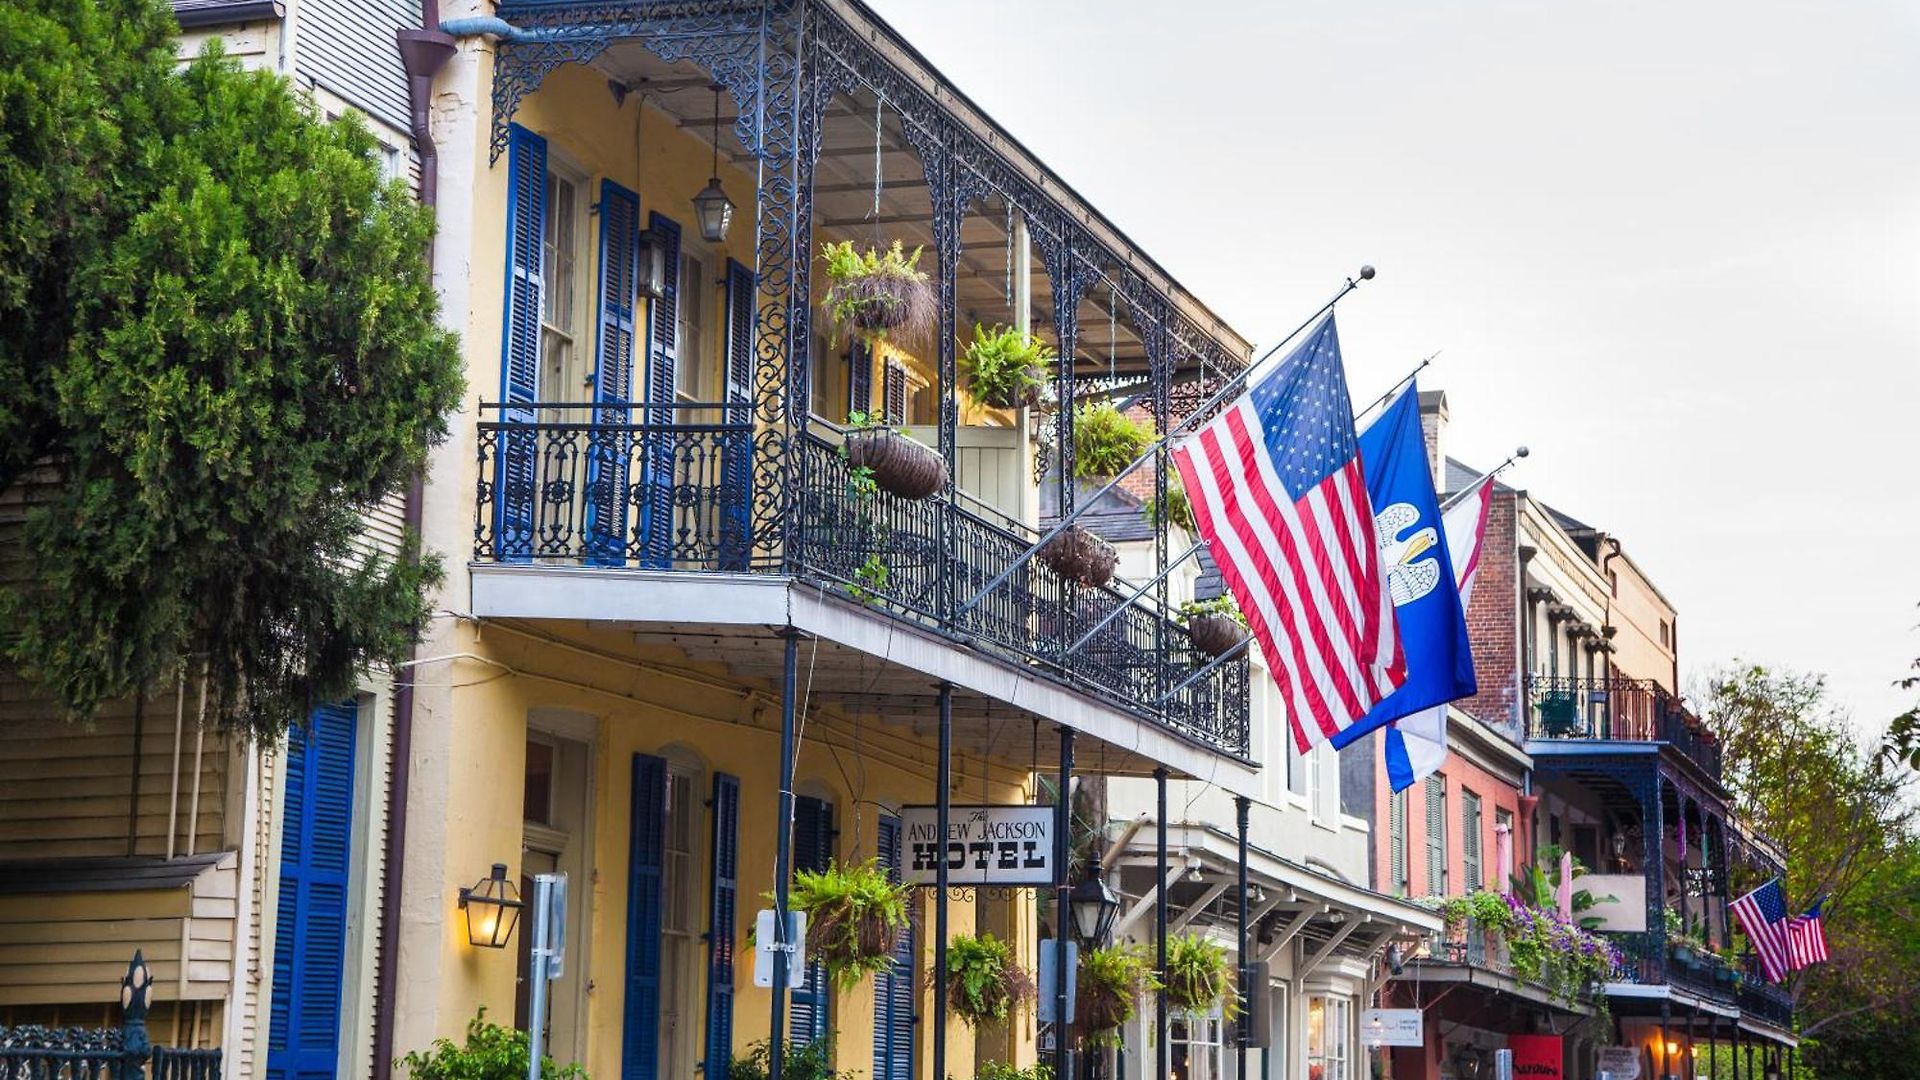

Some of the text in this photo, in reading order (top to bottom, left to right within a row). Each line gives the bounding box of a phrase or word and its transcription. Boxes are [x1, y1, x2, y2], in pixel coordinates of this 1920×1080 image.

[908, 821, 1045, 841] ANDEW JACKSON
[912, 842, 1045, 870] HOTEL
